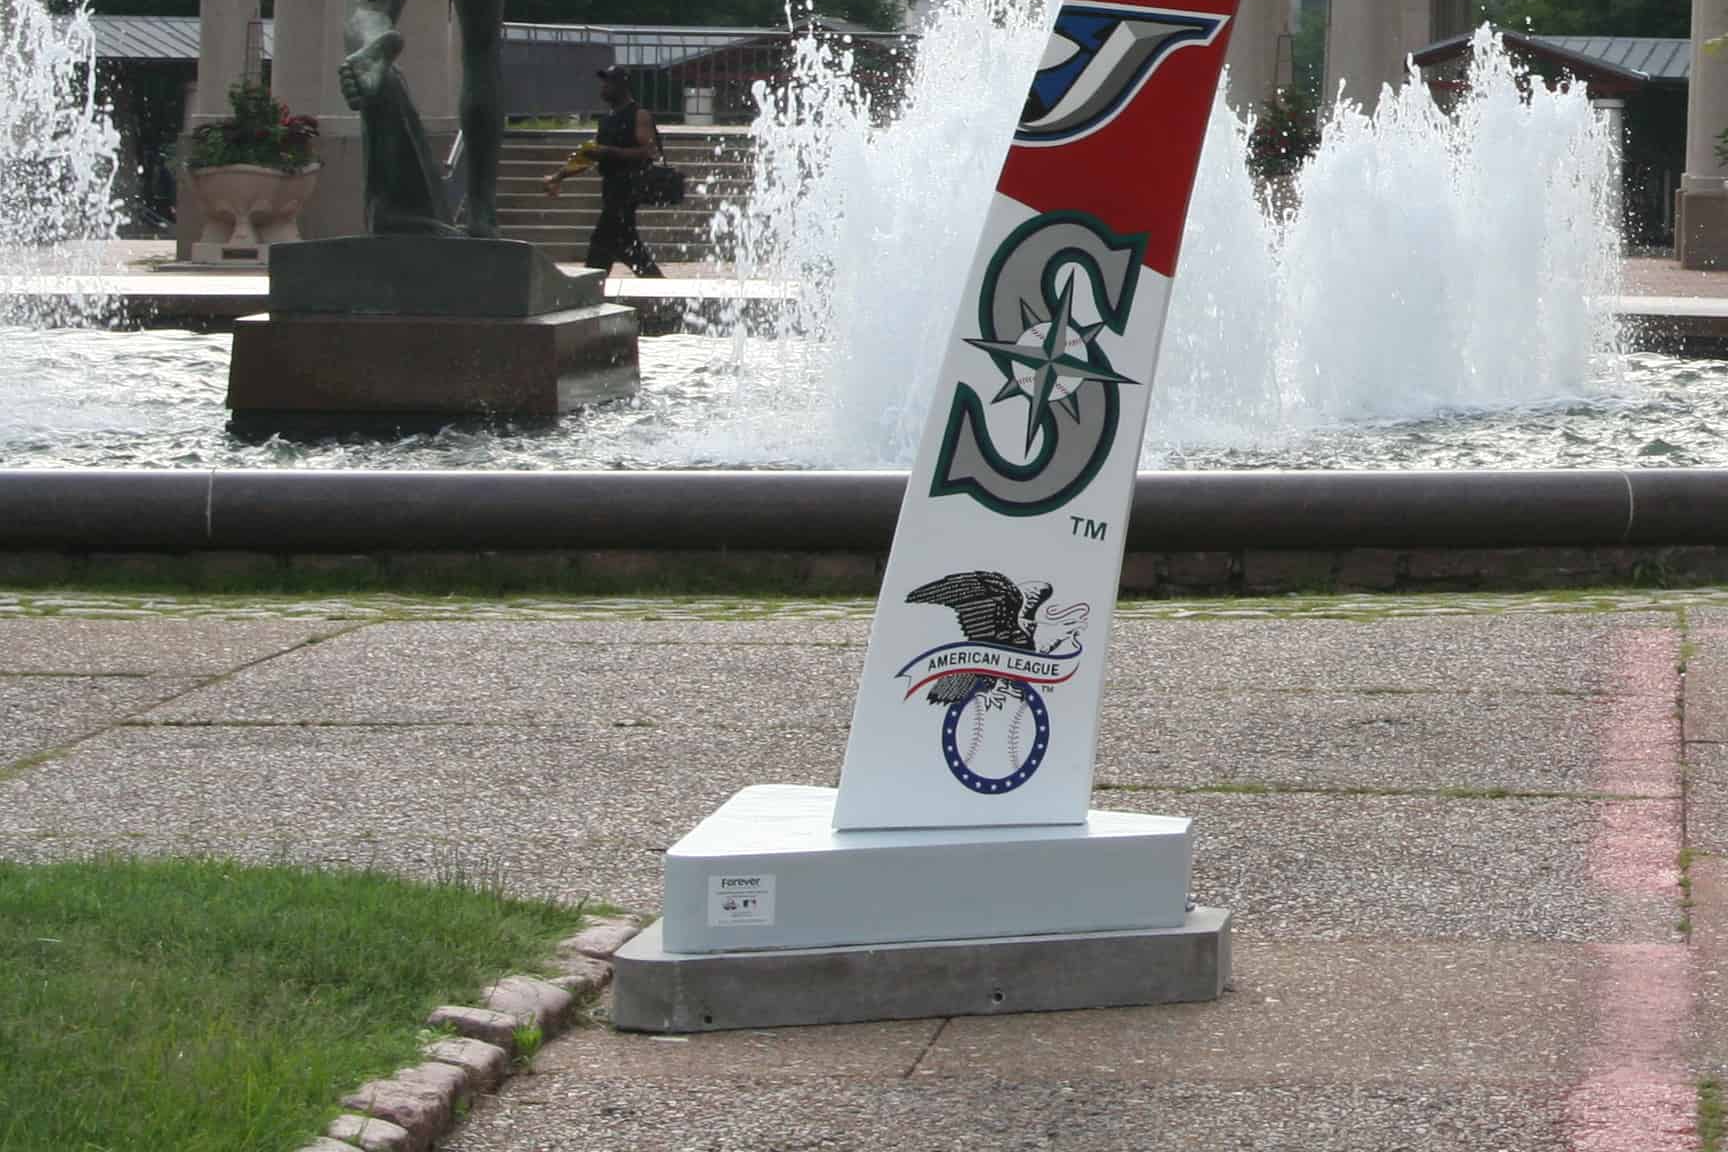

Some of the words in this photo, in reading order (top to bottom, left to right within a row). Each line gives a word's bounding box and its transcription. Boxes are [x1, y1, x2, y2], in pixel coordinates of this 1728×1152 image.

[1069, 515, 1107, 541] TM
[927, 651, 1000, 672] AMERICAN
[1007, 658, 1060, 677] LEAGUE
